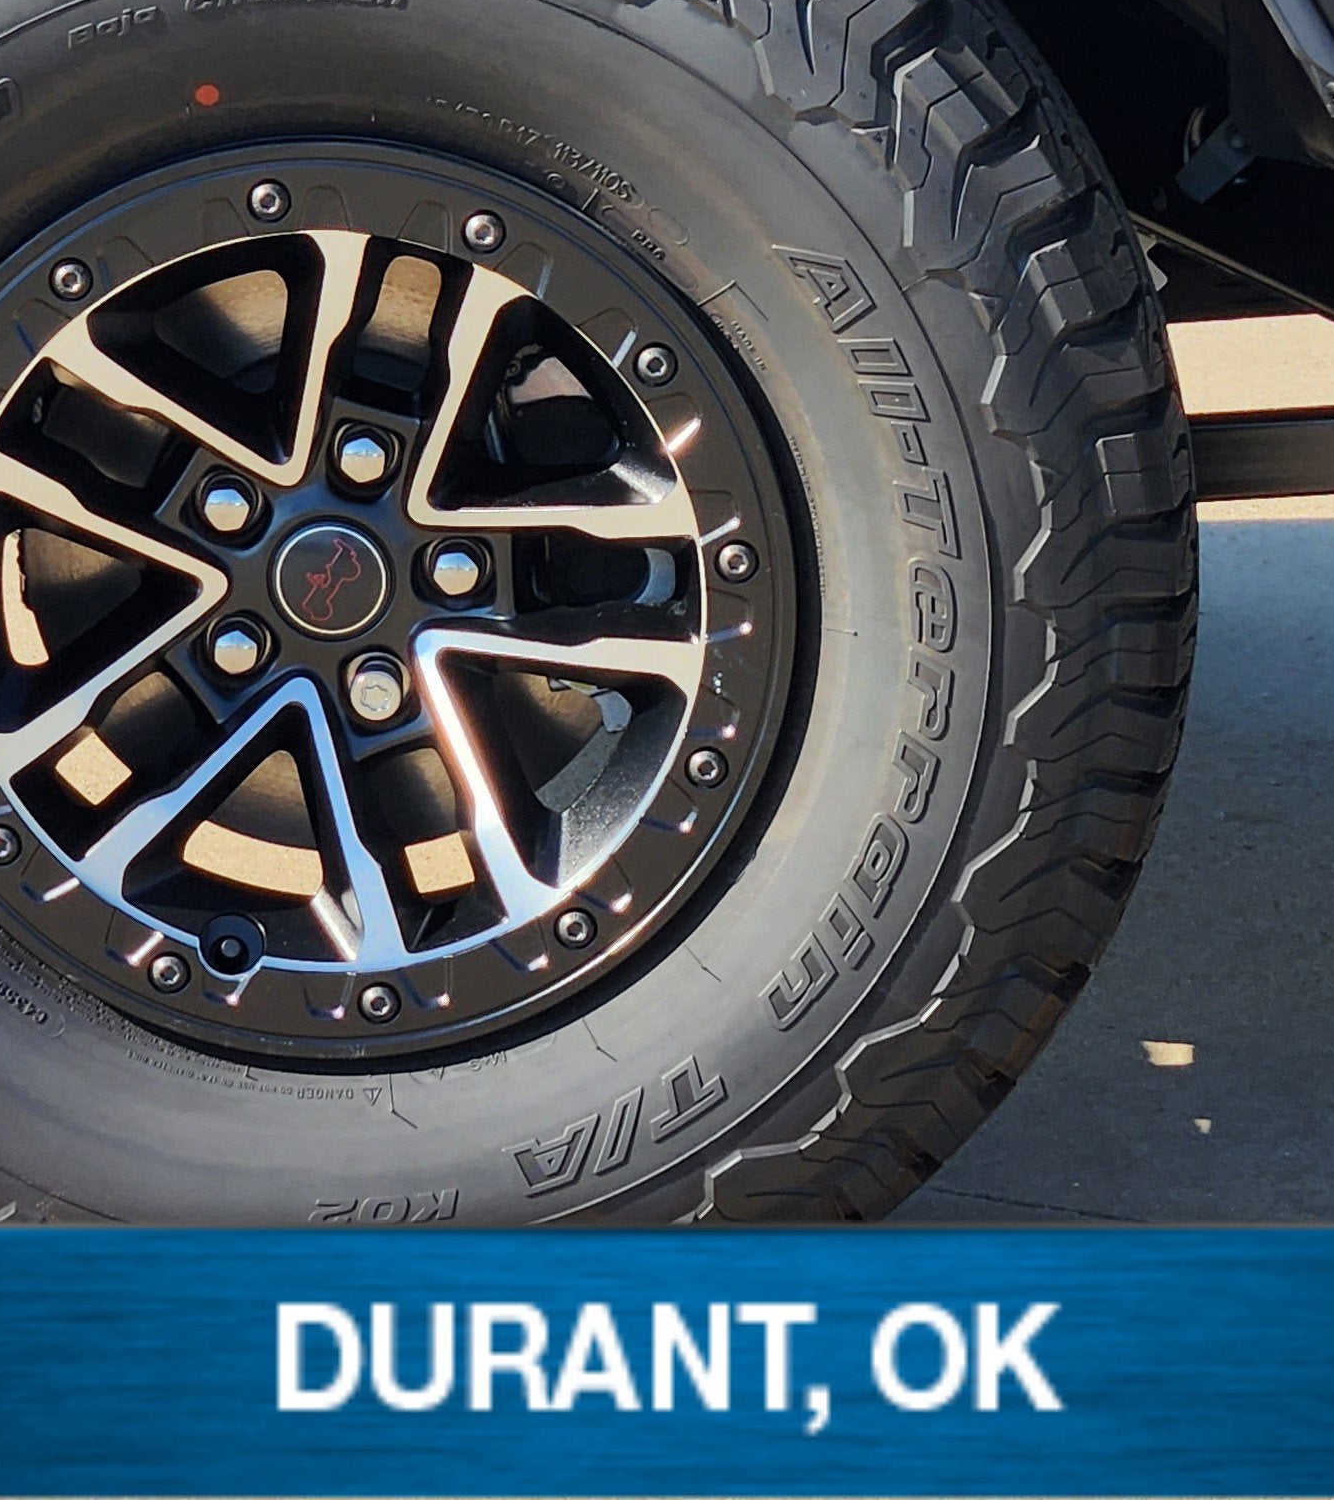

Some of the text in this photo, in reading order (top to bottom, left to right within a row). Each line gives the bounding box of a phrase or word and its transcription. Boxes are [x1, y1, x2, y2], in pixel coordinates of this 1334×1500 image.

[67, 4, 158, 49] Baja
[296, 1087, 355, 1101] DANGER
[501, 1054, 729, 1199] T/A
